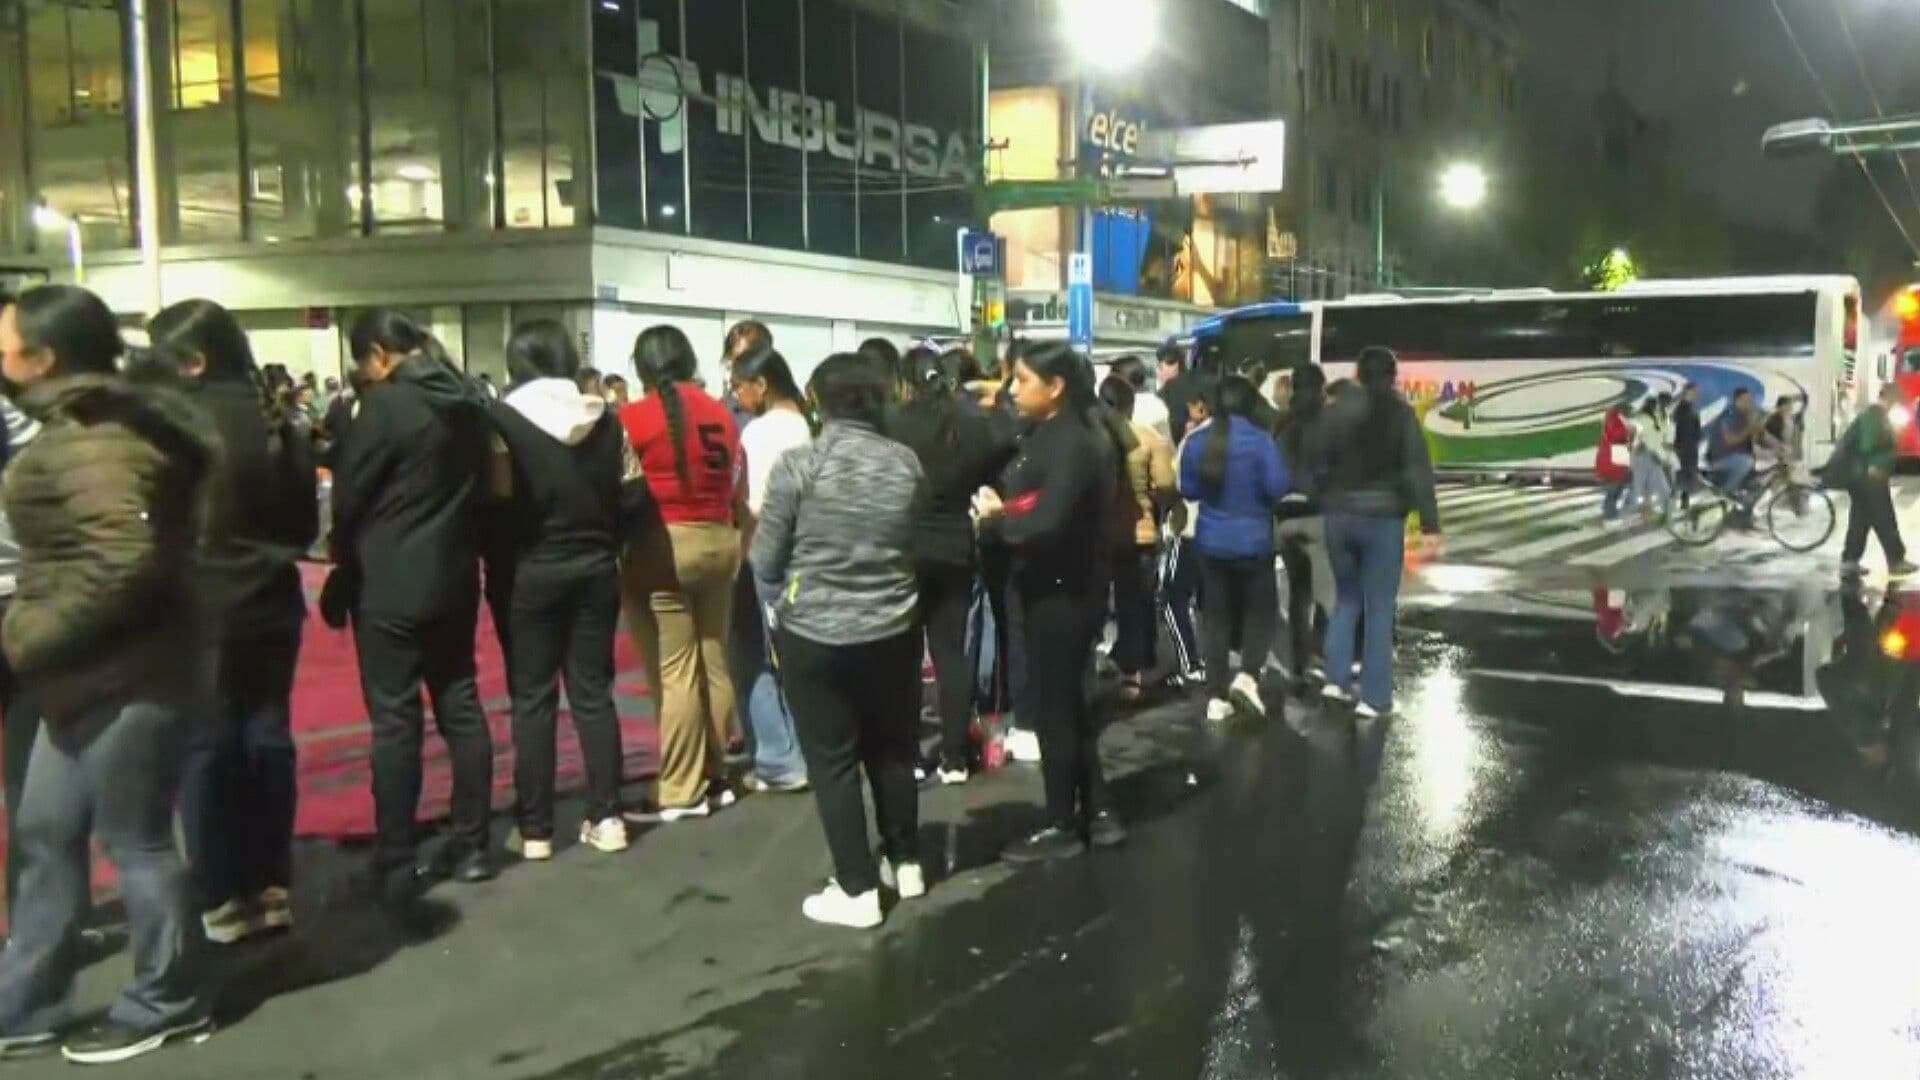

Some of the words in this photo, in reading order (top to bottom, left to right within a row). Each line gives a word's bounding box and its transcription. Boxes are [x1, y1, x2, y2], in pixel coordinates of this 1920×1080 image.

[715, 71, 973, 181] INBURSA
[1088, 107, 1147, 154] elce
[697, 424, 729, 470] 5
